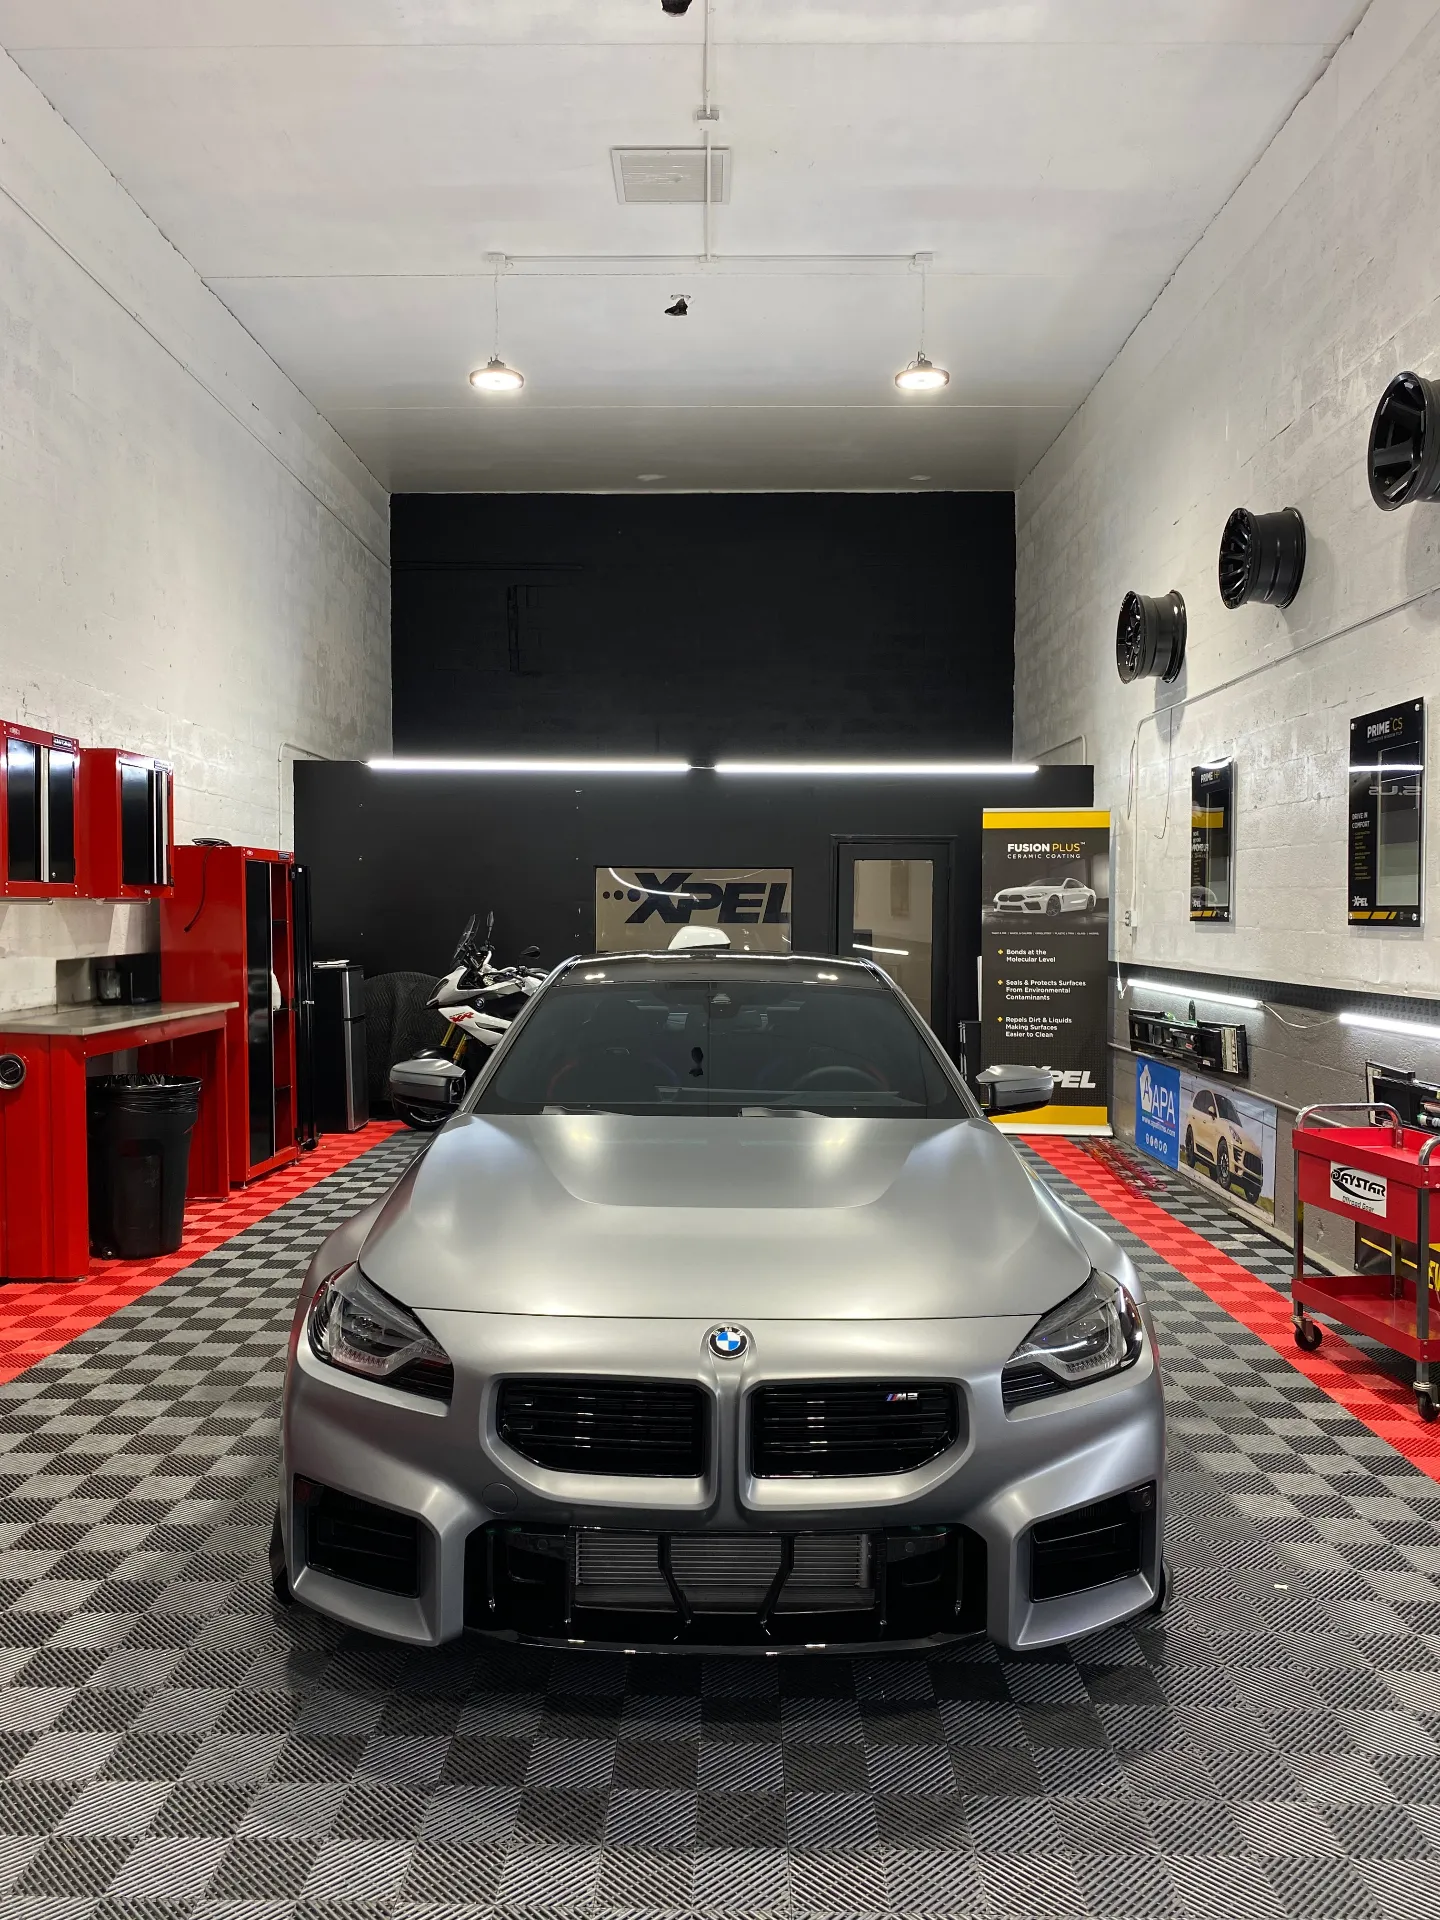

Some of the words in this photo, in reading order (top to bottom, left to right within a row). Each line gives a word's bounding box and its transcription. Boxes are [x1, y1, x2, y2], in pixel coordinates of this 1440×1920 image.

[1367, 720, 1390, 738] PRIME
[1392, 717, 1403, 731] CS
[1007, 843, 1050, 853] FUSION
[624, 872, 791, 924] XPEL
[1024, 986, 1071, 994] Environmental
[1005, 1016, 1028, 1024] Repels
[1029, 1065, 1096, 1089] PEL
[1151, 1084, 1176, 1125] APA
[1330, 1168, 1386, 1198] DAYSTAR
[1361, 1201, 1375, 1213] Gear
